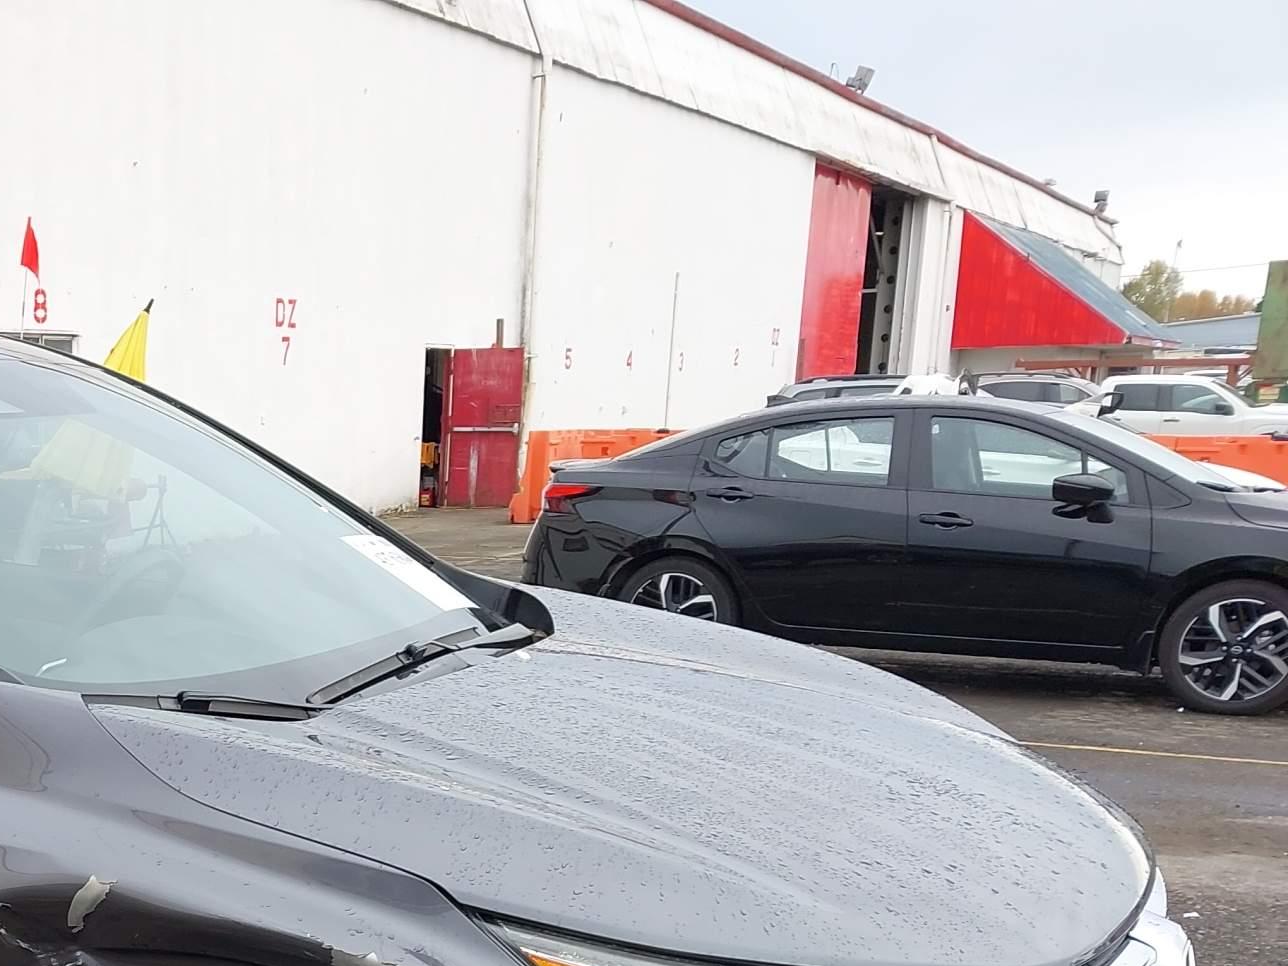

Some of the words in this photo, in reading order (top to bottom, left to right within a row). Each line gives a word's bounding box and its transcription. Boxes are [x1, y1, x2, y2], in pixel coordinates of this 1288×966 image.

[33, 288, 48, 324] 8
[275, 298, 297, 329] DZ
[281, 336, 291, 366] 7
[564, 348, 572, 369] 5
[626, 351, 633, 370] 4
